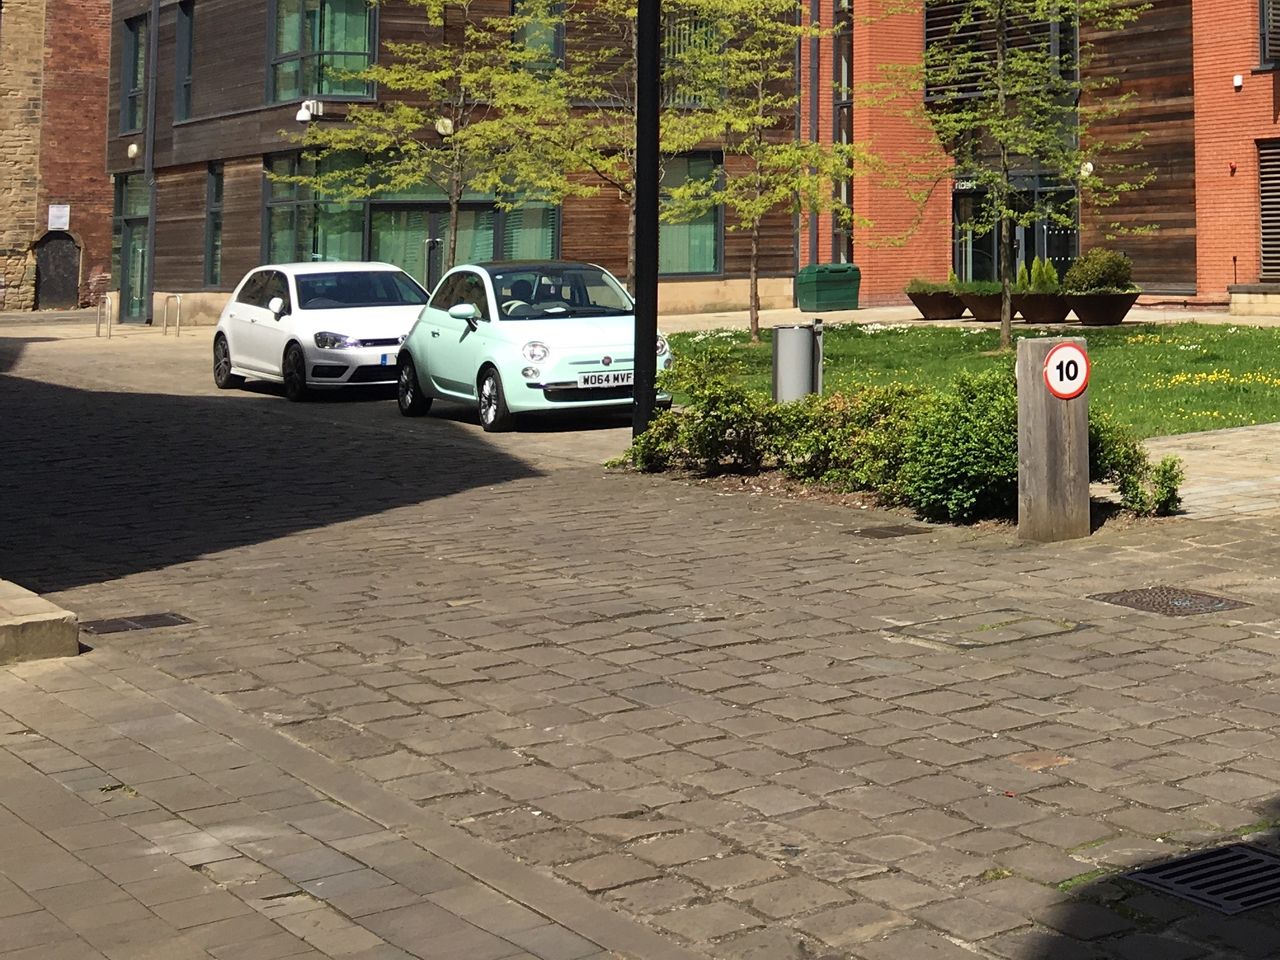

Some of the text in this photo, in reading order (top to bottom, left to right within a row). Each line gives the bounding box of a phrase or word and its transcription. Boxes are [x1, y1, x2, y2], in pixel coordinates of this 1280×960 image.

[583, 372, 633, 386] WO64 MVF
[1056, 359, 1079, 382] 10
